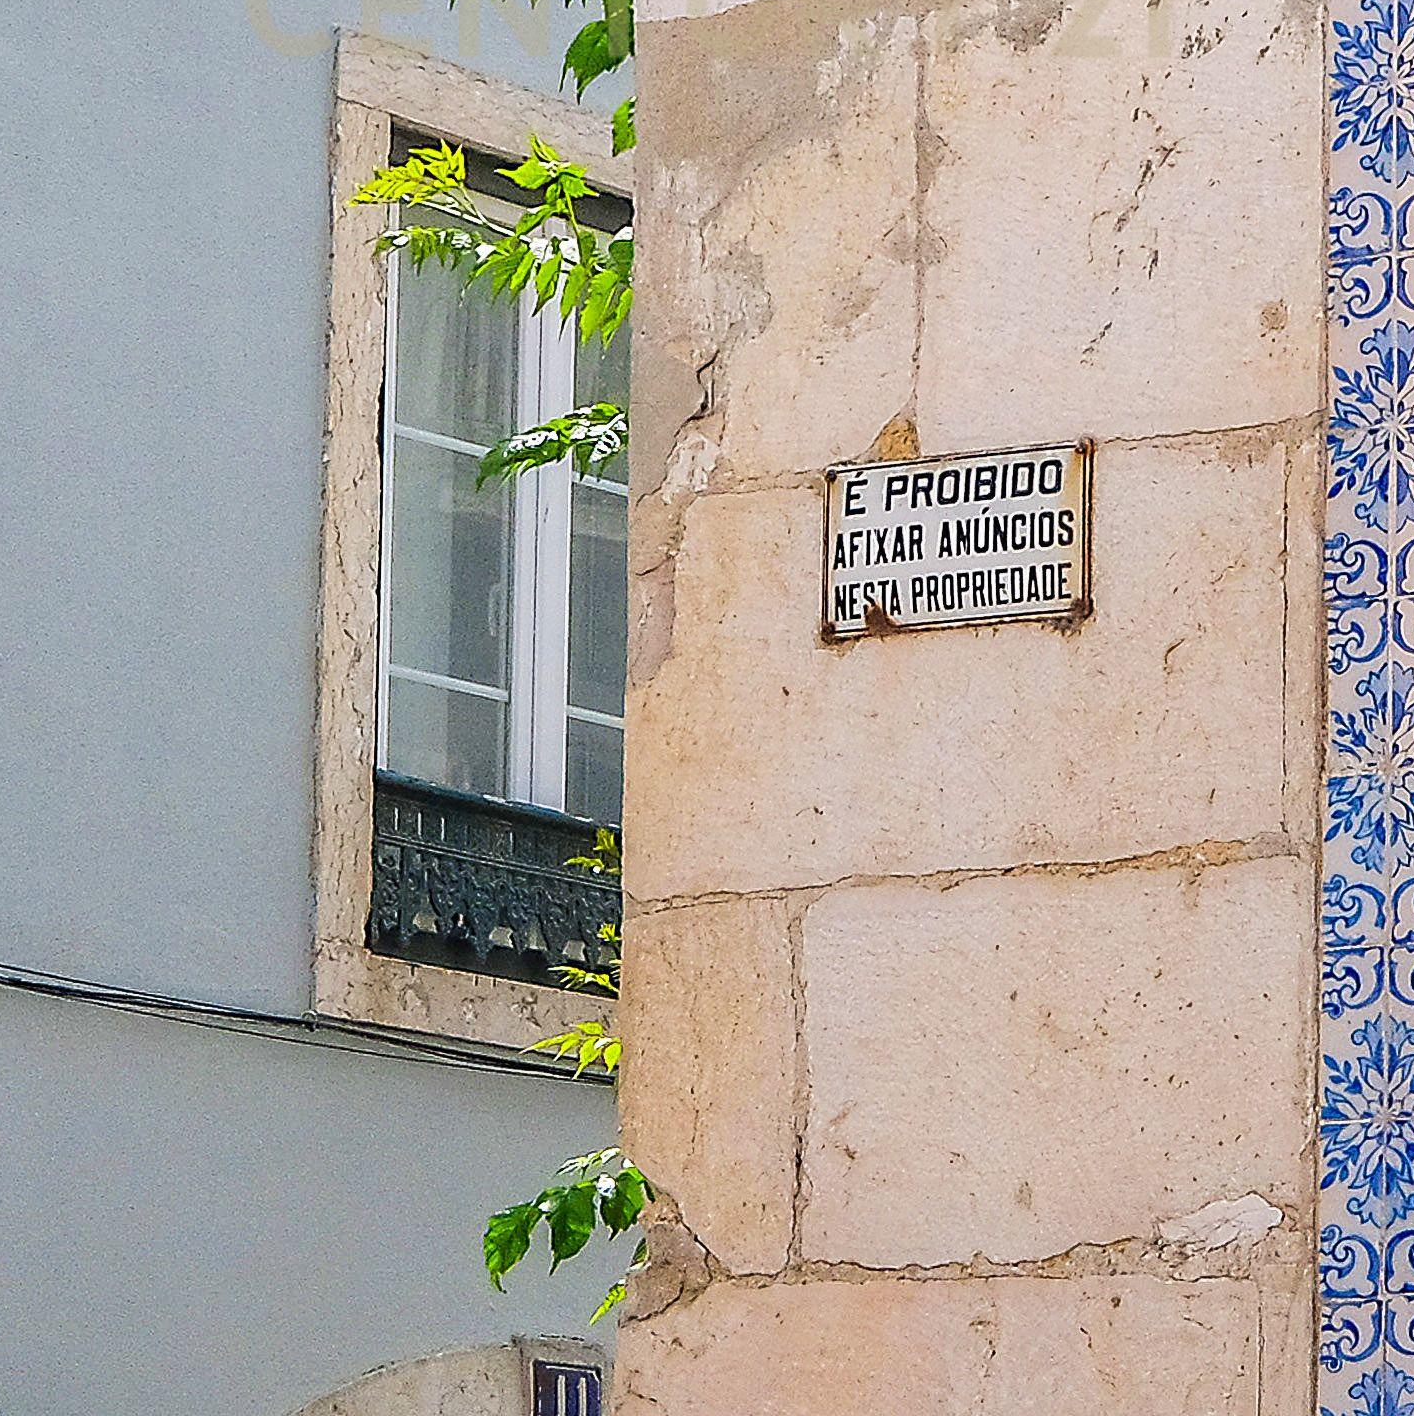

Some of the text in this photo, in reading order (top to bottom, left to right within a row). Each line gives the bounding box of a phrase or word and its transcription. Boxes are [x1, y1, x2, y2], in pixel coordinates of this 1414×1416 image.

[844, 459, 1063, 516] É PROIBIDO
[833, 507, 1075, 570] AFIXAR ANÚNCIOS
[835, 562, 1073, 622] NESTA PROPRIEDADE
